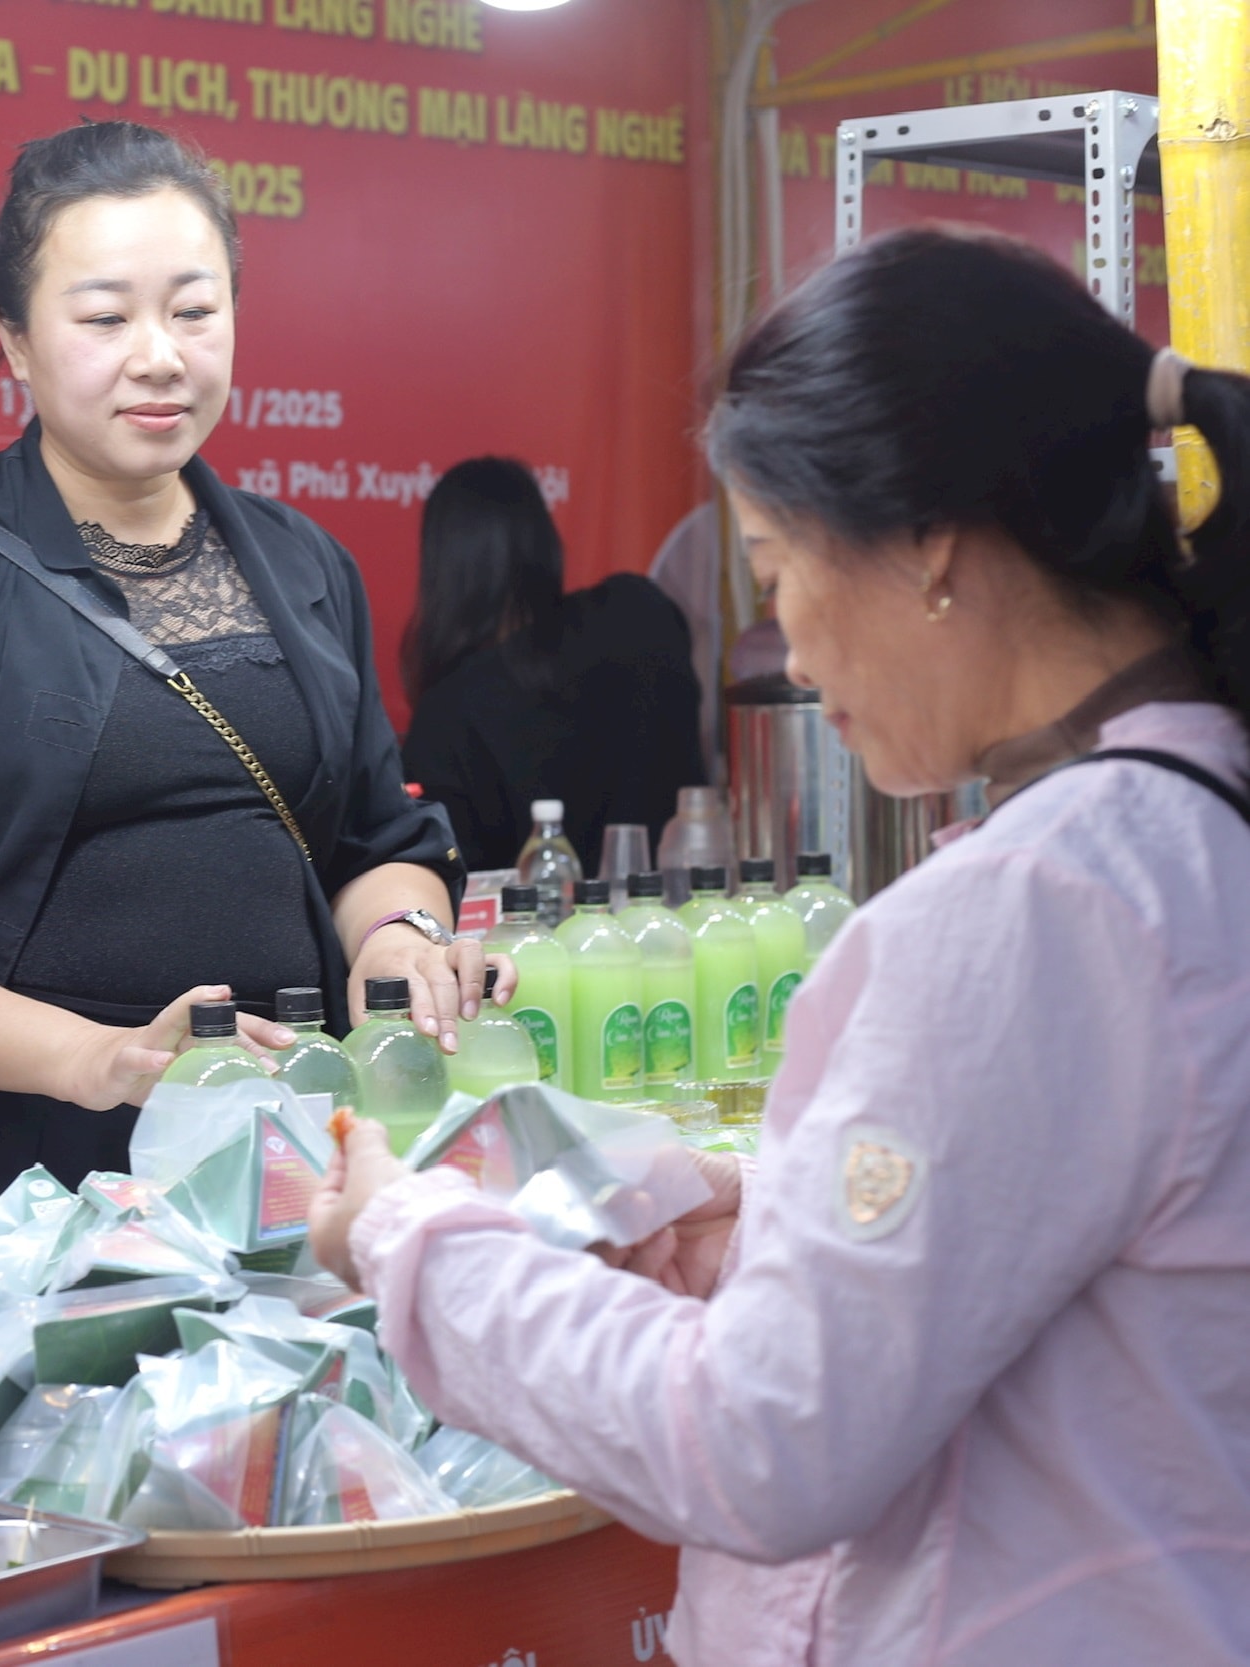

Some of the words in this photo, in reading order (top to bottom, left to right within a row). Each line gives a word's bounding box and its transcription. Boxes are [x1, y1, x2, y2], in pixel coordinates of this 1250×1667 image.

[67, 48, 129, 101] DU
[141, 55, 238, 121] LỊCH,
[248, 67, 409, 136] THƯƠNG
[419, 87, 487, 147] MẠI
[497, 90, 589, 155] LÀNG
[228, 387, 344, 429] 1/2025
[288, 460, 349, 499] Phú
[355, 463, 440, 507] Xuyê
